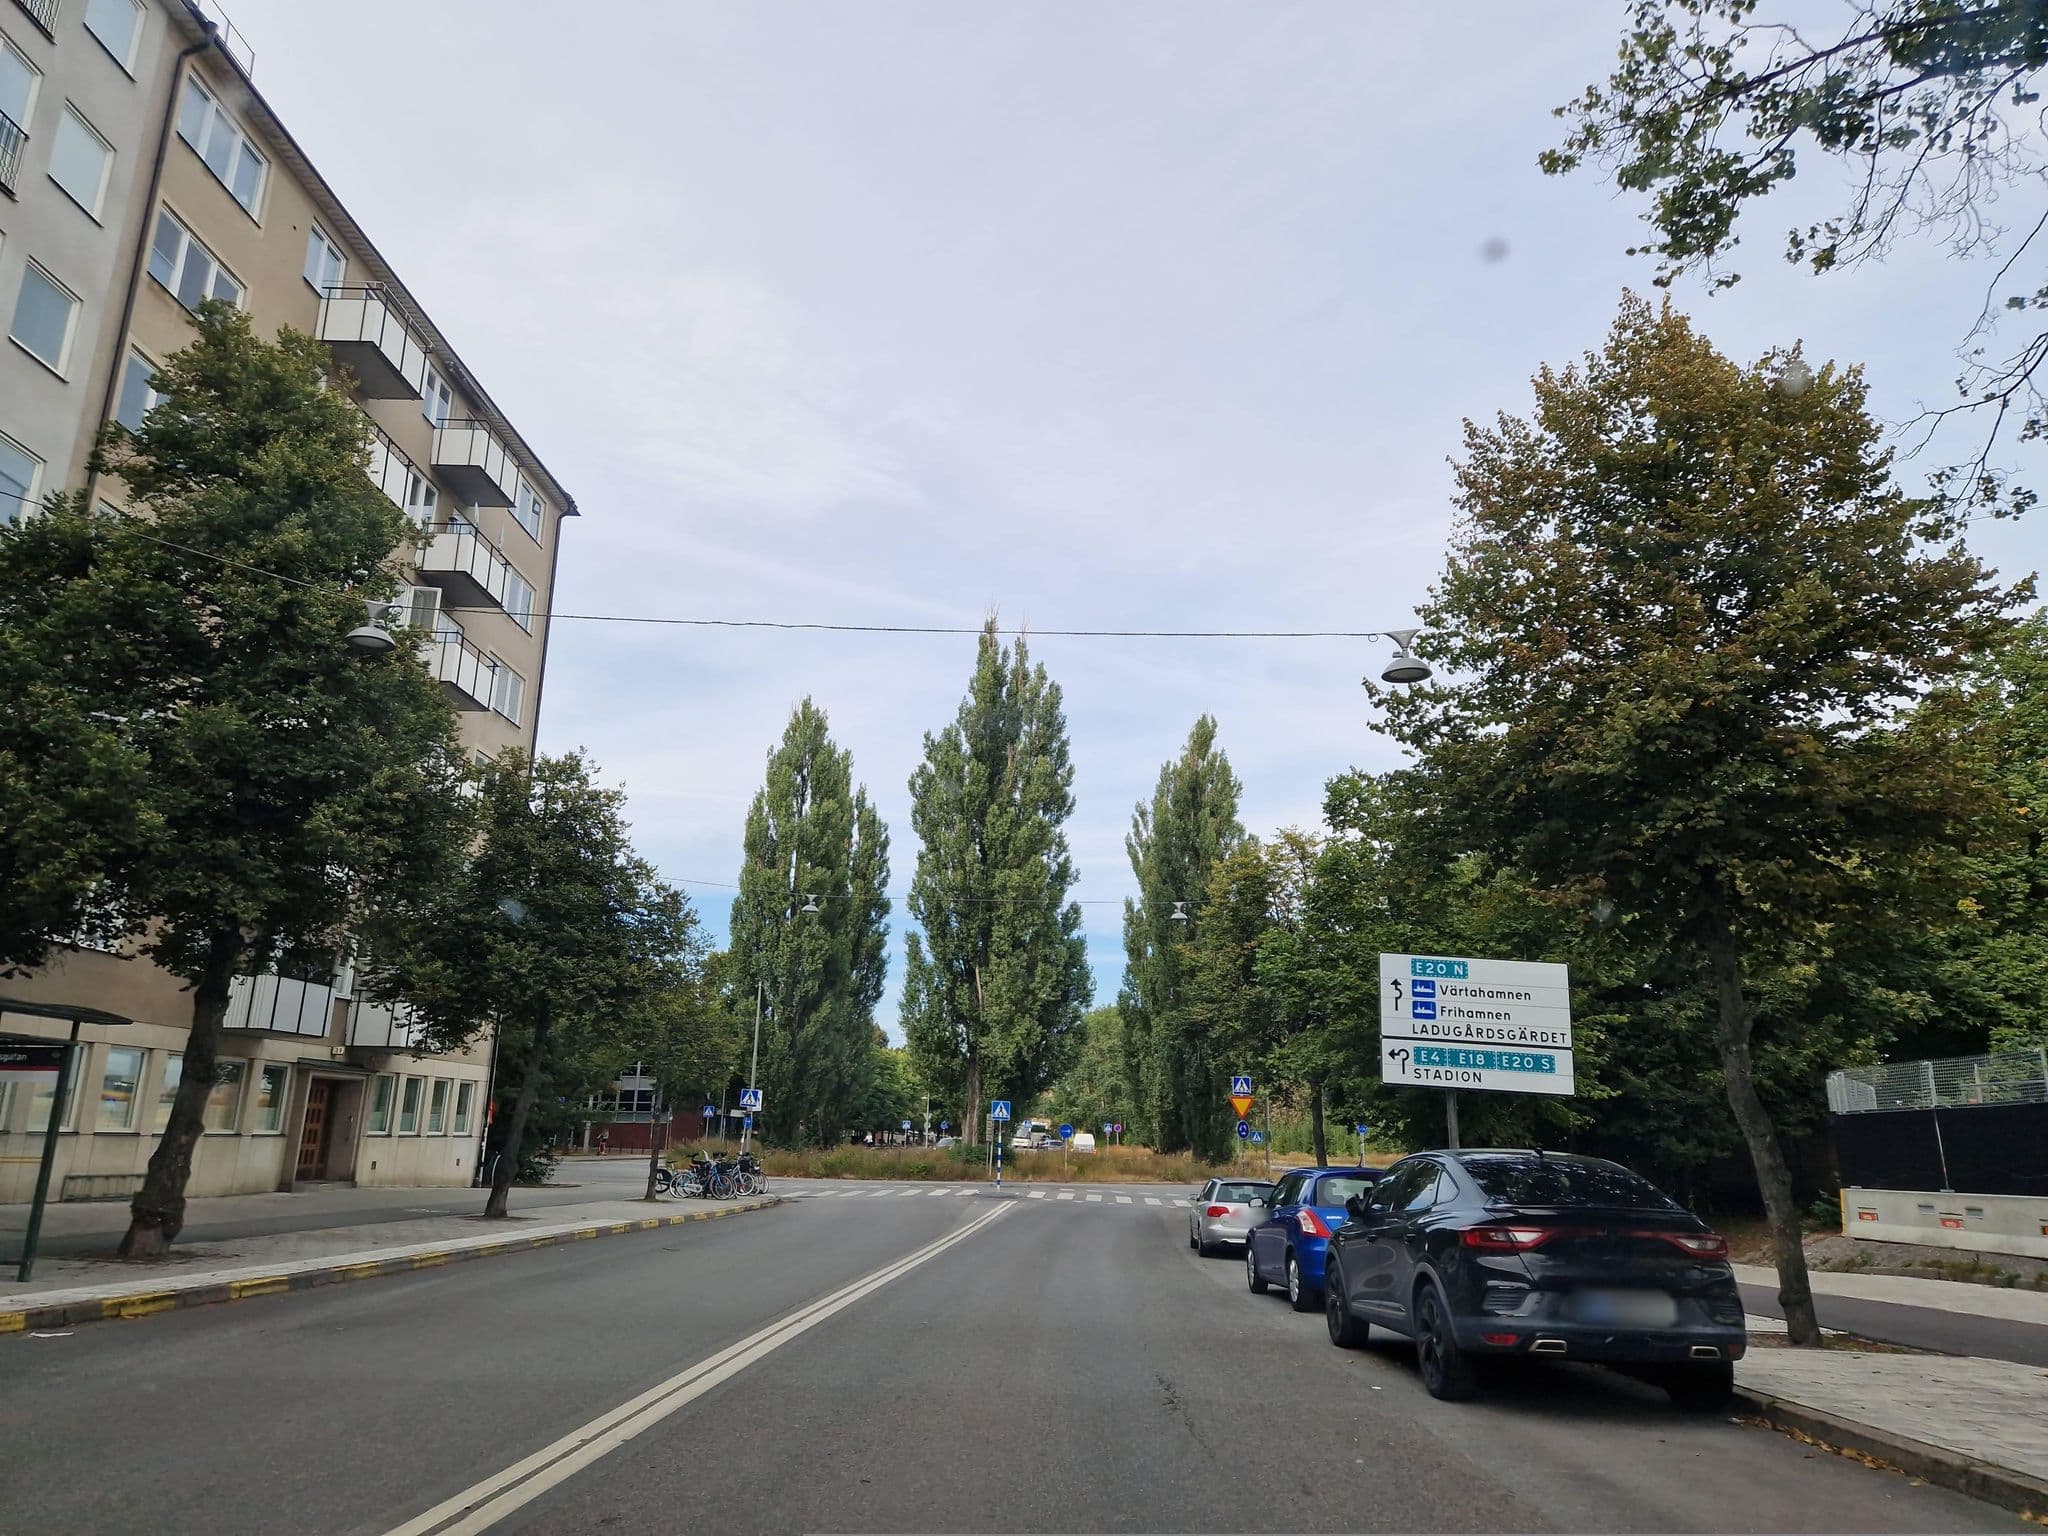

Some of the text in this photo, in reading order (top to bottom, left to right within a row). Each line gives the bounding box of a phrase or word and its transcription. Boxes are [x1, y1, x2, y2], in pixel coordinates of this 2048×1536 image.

[1416, 963, 1464, 975] E20 N
[1440, 986, 1531, 1000] Värtahamnen
[1441, 1006, 1511, 1020] Frihamnen
[1412, 1023, 1567, 1044] LADUGÅRDSGÄRDET
[1421, 1051, 1440, 1062] E4
[1459, 1053, 1485, 1065] E18
[1502, 1056, 1550, 1070] E20 S
[1414, 1069, 1482, 1083] STADION
